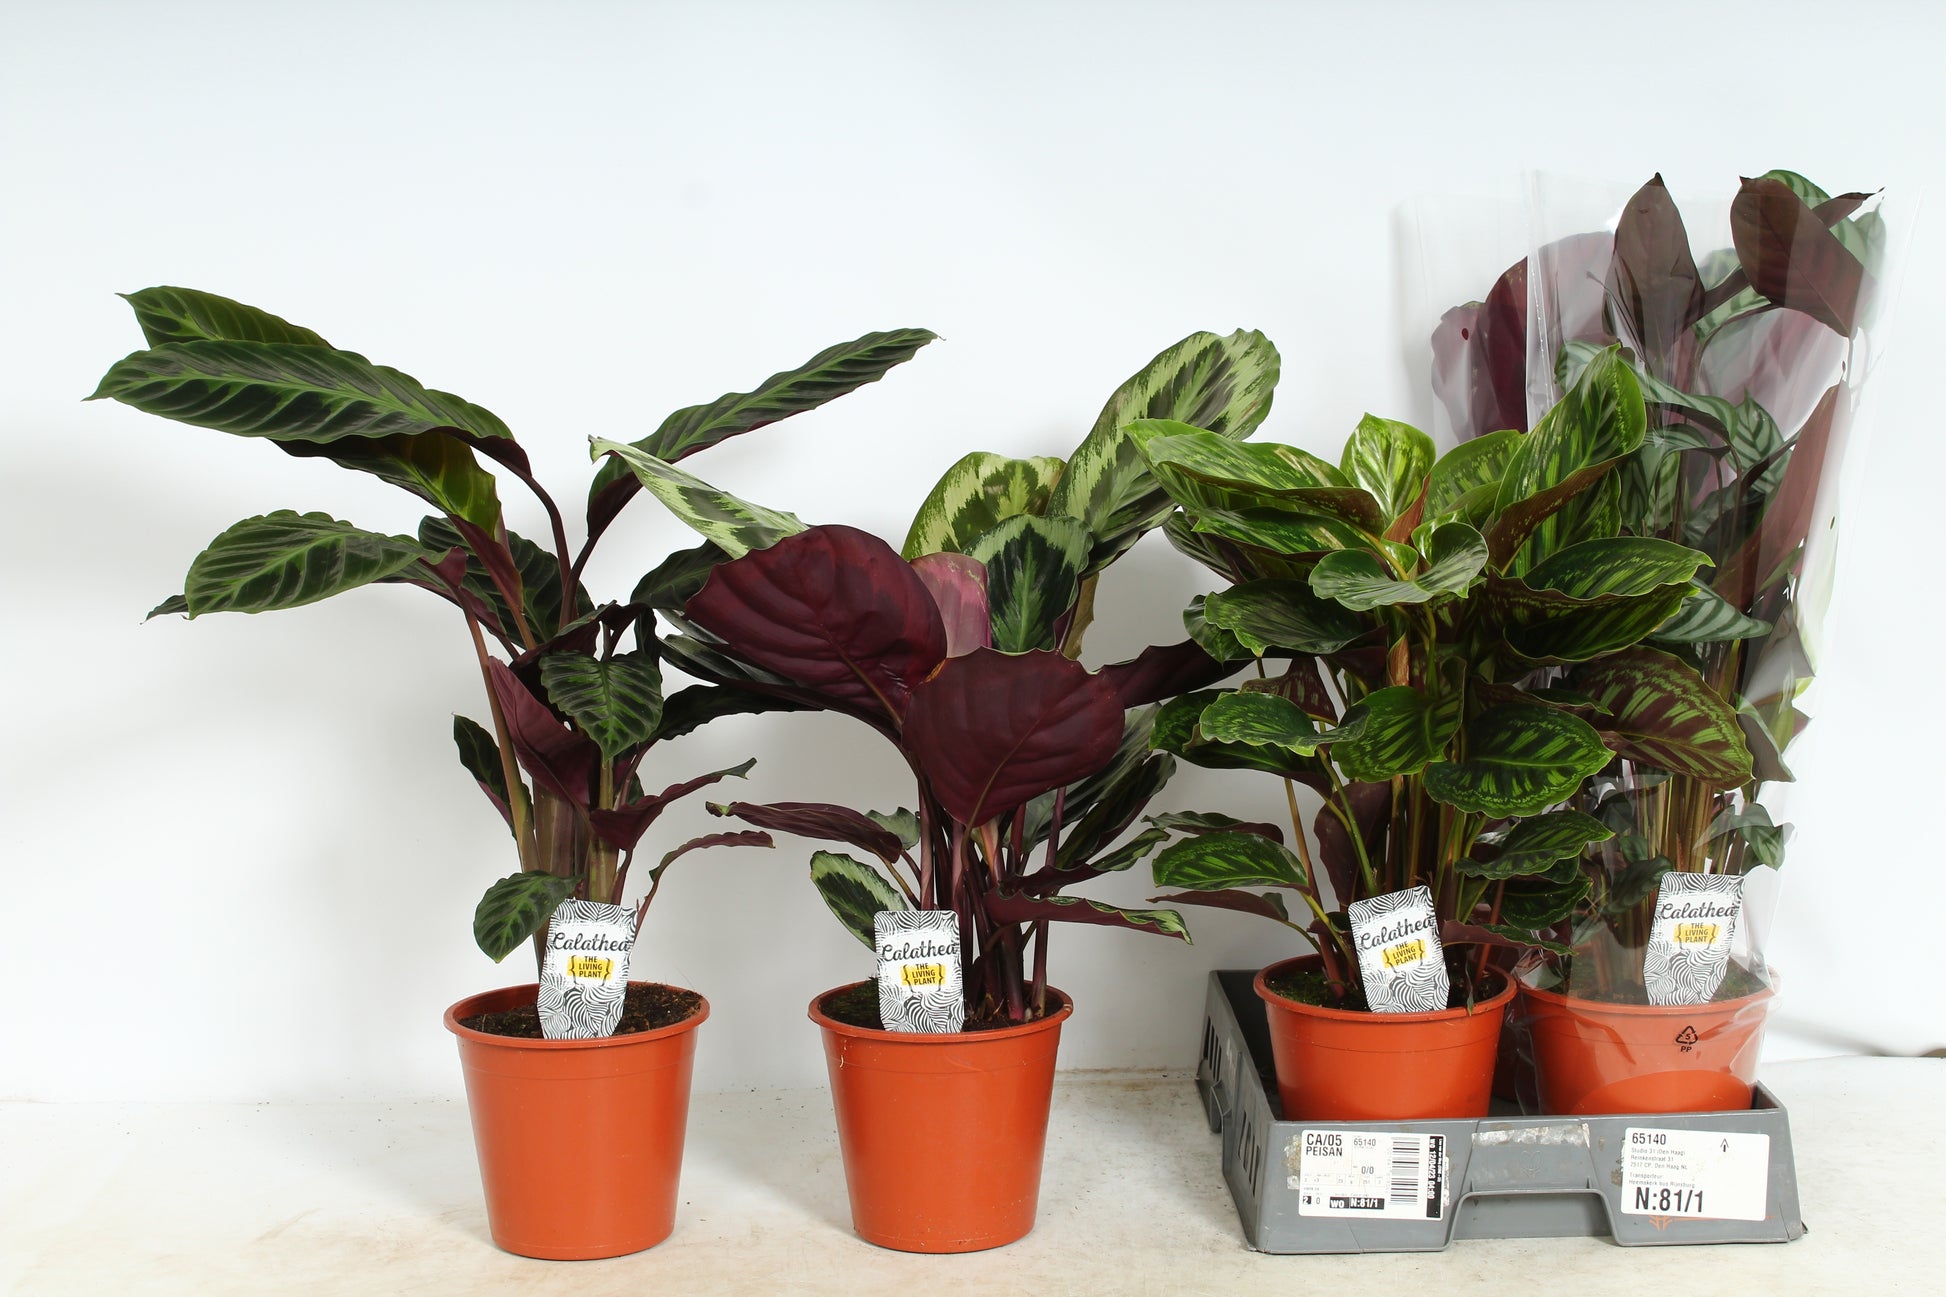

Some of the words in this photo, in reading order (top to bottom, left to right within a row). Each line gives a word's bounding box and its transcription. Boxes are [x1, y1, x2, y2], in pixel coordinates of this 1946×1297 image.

[1661, 902, 1735, 920] Calathea
[1360, 916, 1434, 950] Calathea
[552, 932, 629, 952] Calathea
[1684, 935, 1708, 943] PLANT
[881, 940, 957, 962] Calathea
[1395, 941, 1409, 951] THE
[1392, 947, 1416, 959] LIVING
[1395, 953, 1418, 966] PLANT
[578, 963, 603, 971] LIVING
[578, 970, 602, 978] PLANT
[911, 970, 936, 979] LIVING
[913, 977, 936, 986] PLANT
[1307, 1133, 1343, 1146] CA/05
[1353, 1138, 1377, 1147] 65140
[1631, 1132, 1667, 1145] 65140
[1306, 1146, 1343, 1157] PEISAN
[1361, 1166, 1374, 1175] 0/0
[1428, 1151, 1437, 1179] 12/04/23
[1351, 1198, 1378, 1208] N:81/1
[1635, 1186, 1703, 1213] N:81/1
